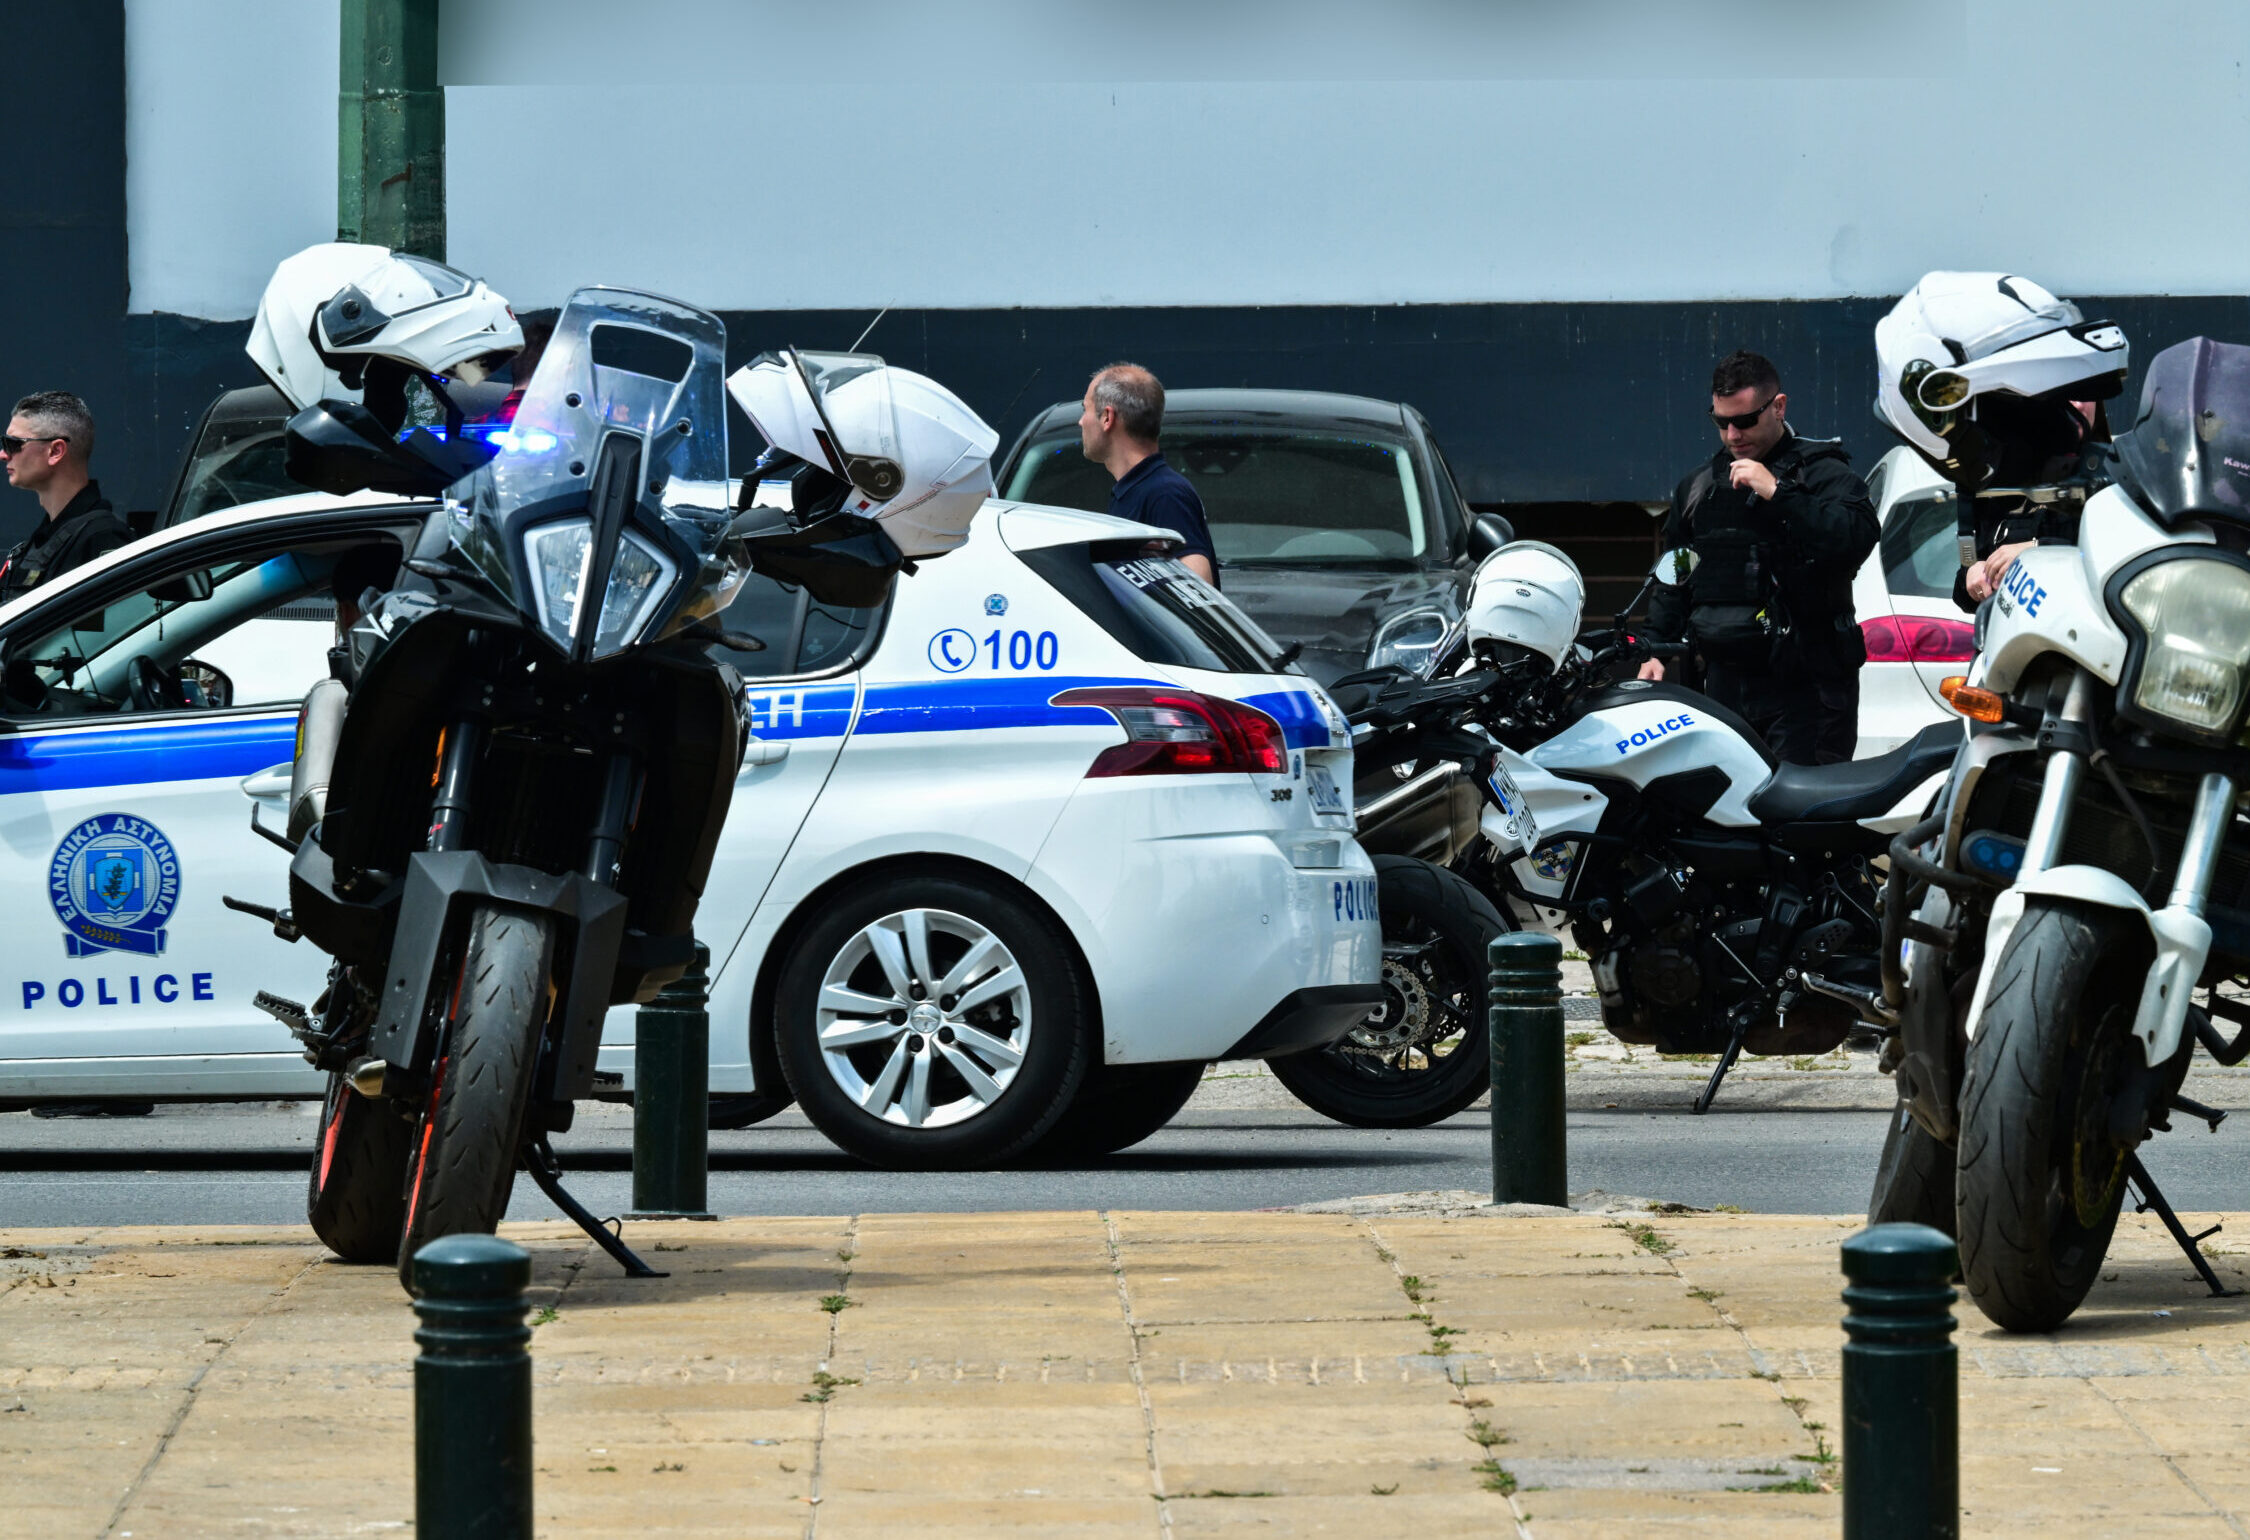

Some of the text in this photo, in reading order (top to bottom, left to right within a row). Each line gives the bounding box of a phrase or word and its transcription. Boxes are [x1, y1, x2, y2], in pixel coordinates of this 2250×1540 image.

[2003, 558, 2047, 618] OLICE
[984, 629, 1059, 670] 100
[1616, 713, 1695, 755] POLICE
[52, 816, 178, 922] ΕΛΛΗΝΙΚΗ ΑΣΤΥΝΟΜΙΑ
[22, 972, 214, 1010] POLICE
